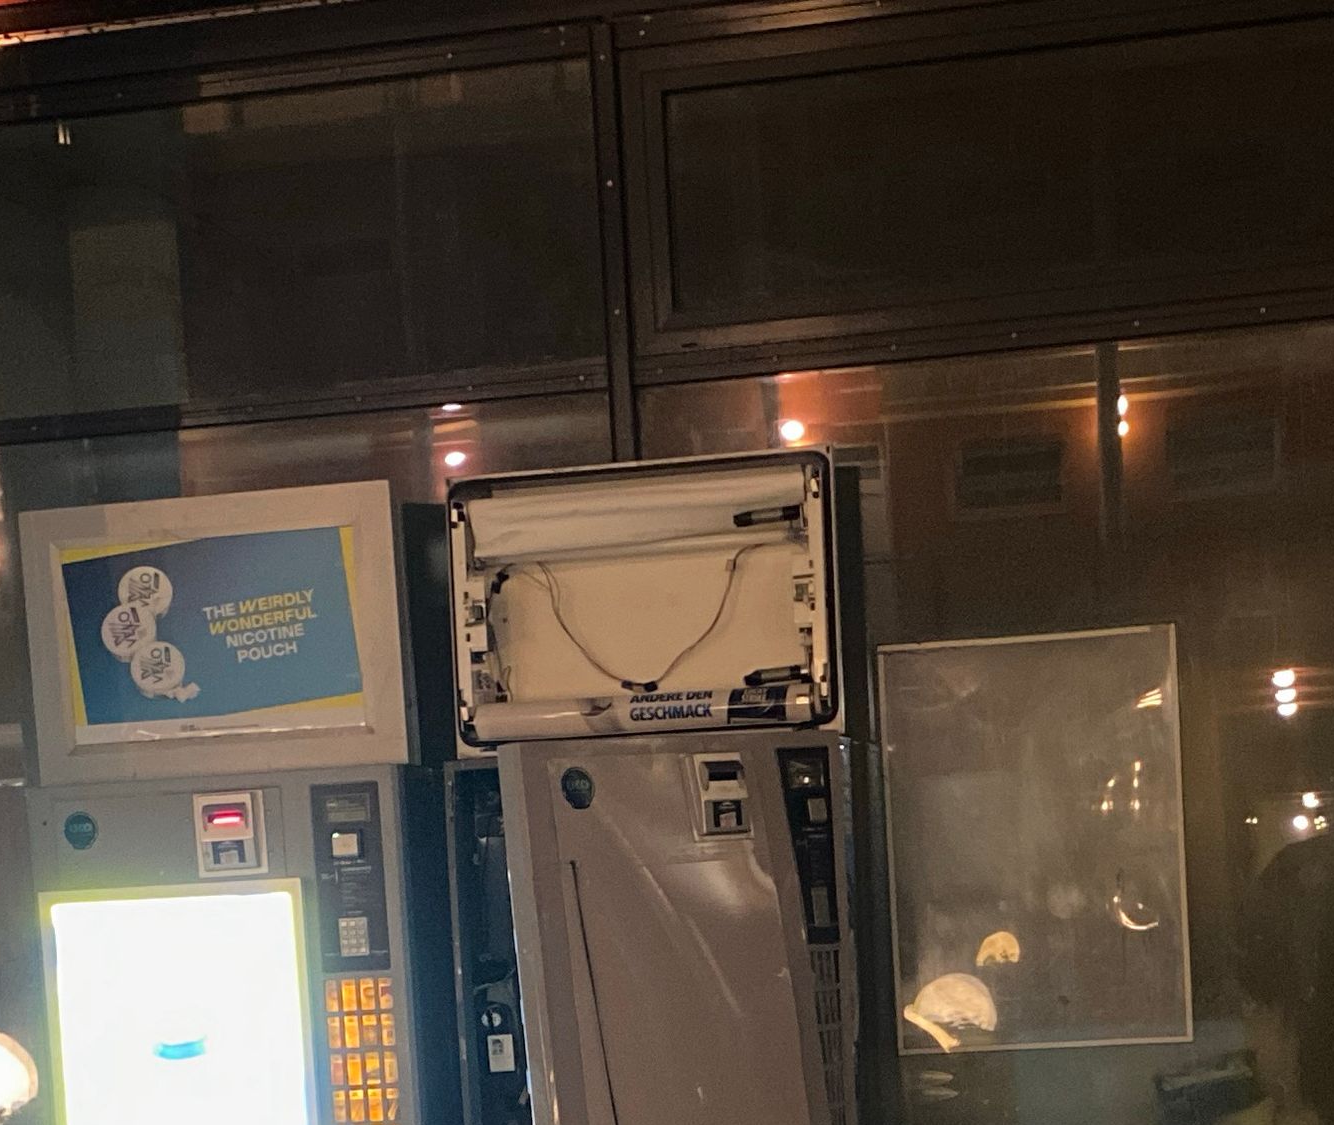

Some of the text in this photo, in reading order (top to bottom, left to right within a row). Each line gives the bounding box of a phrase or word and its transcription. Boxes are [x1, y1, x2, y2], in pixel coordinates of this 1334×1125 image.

[202, 588, 314, 620] THE WEIRDLY
[209, 606, 317, 635] WONDERFUL
[225, 623, 305, 648] NICOTINE
[236, 641, 298, 663] POUCH
[629, 703, 713, 721] GESCHMACK
